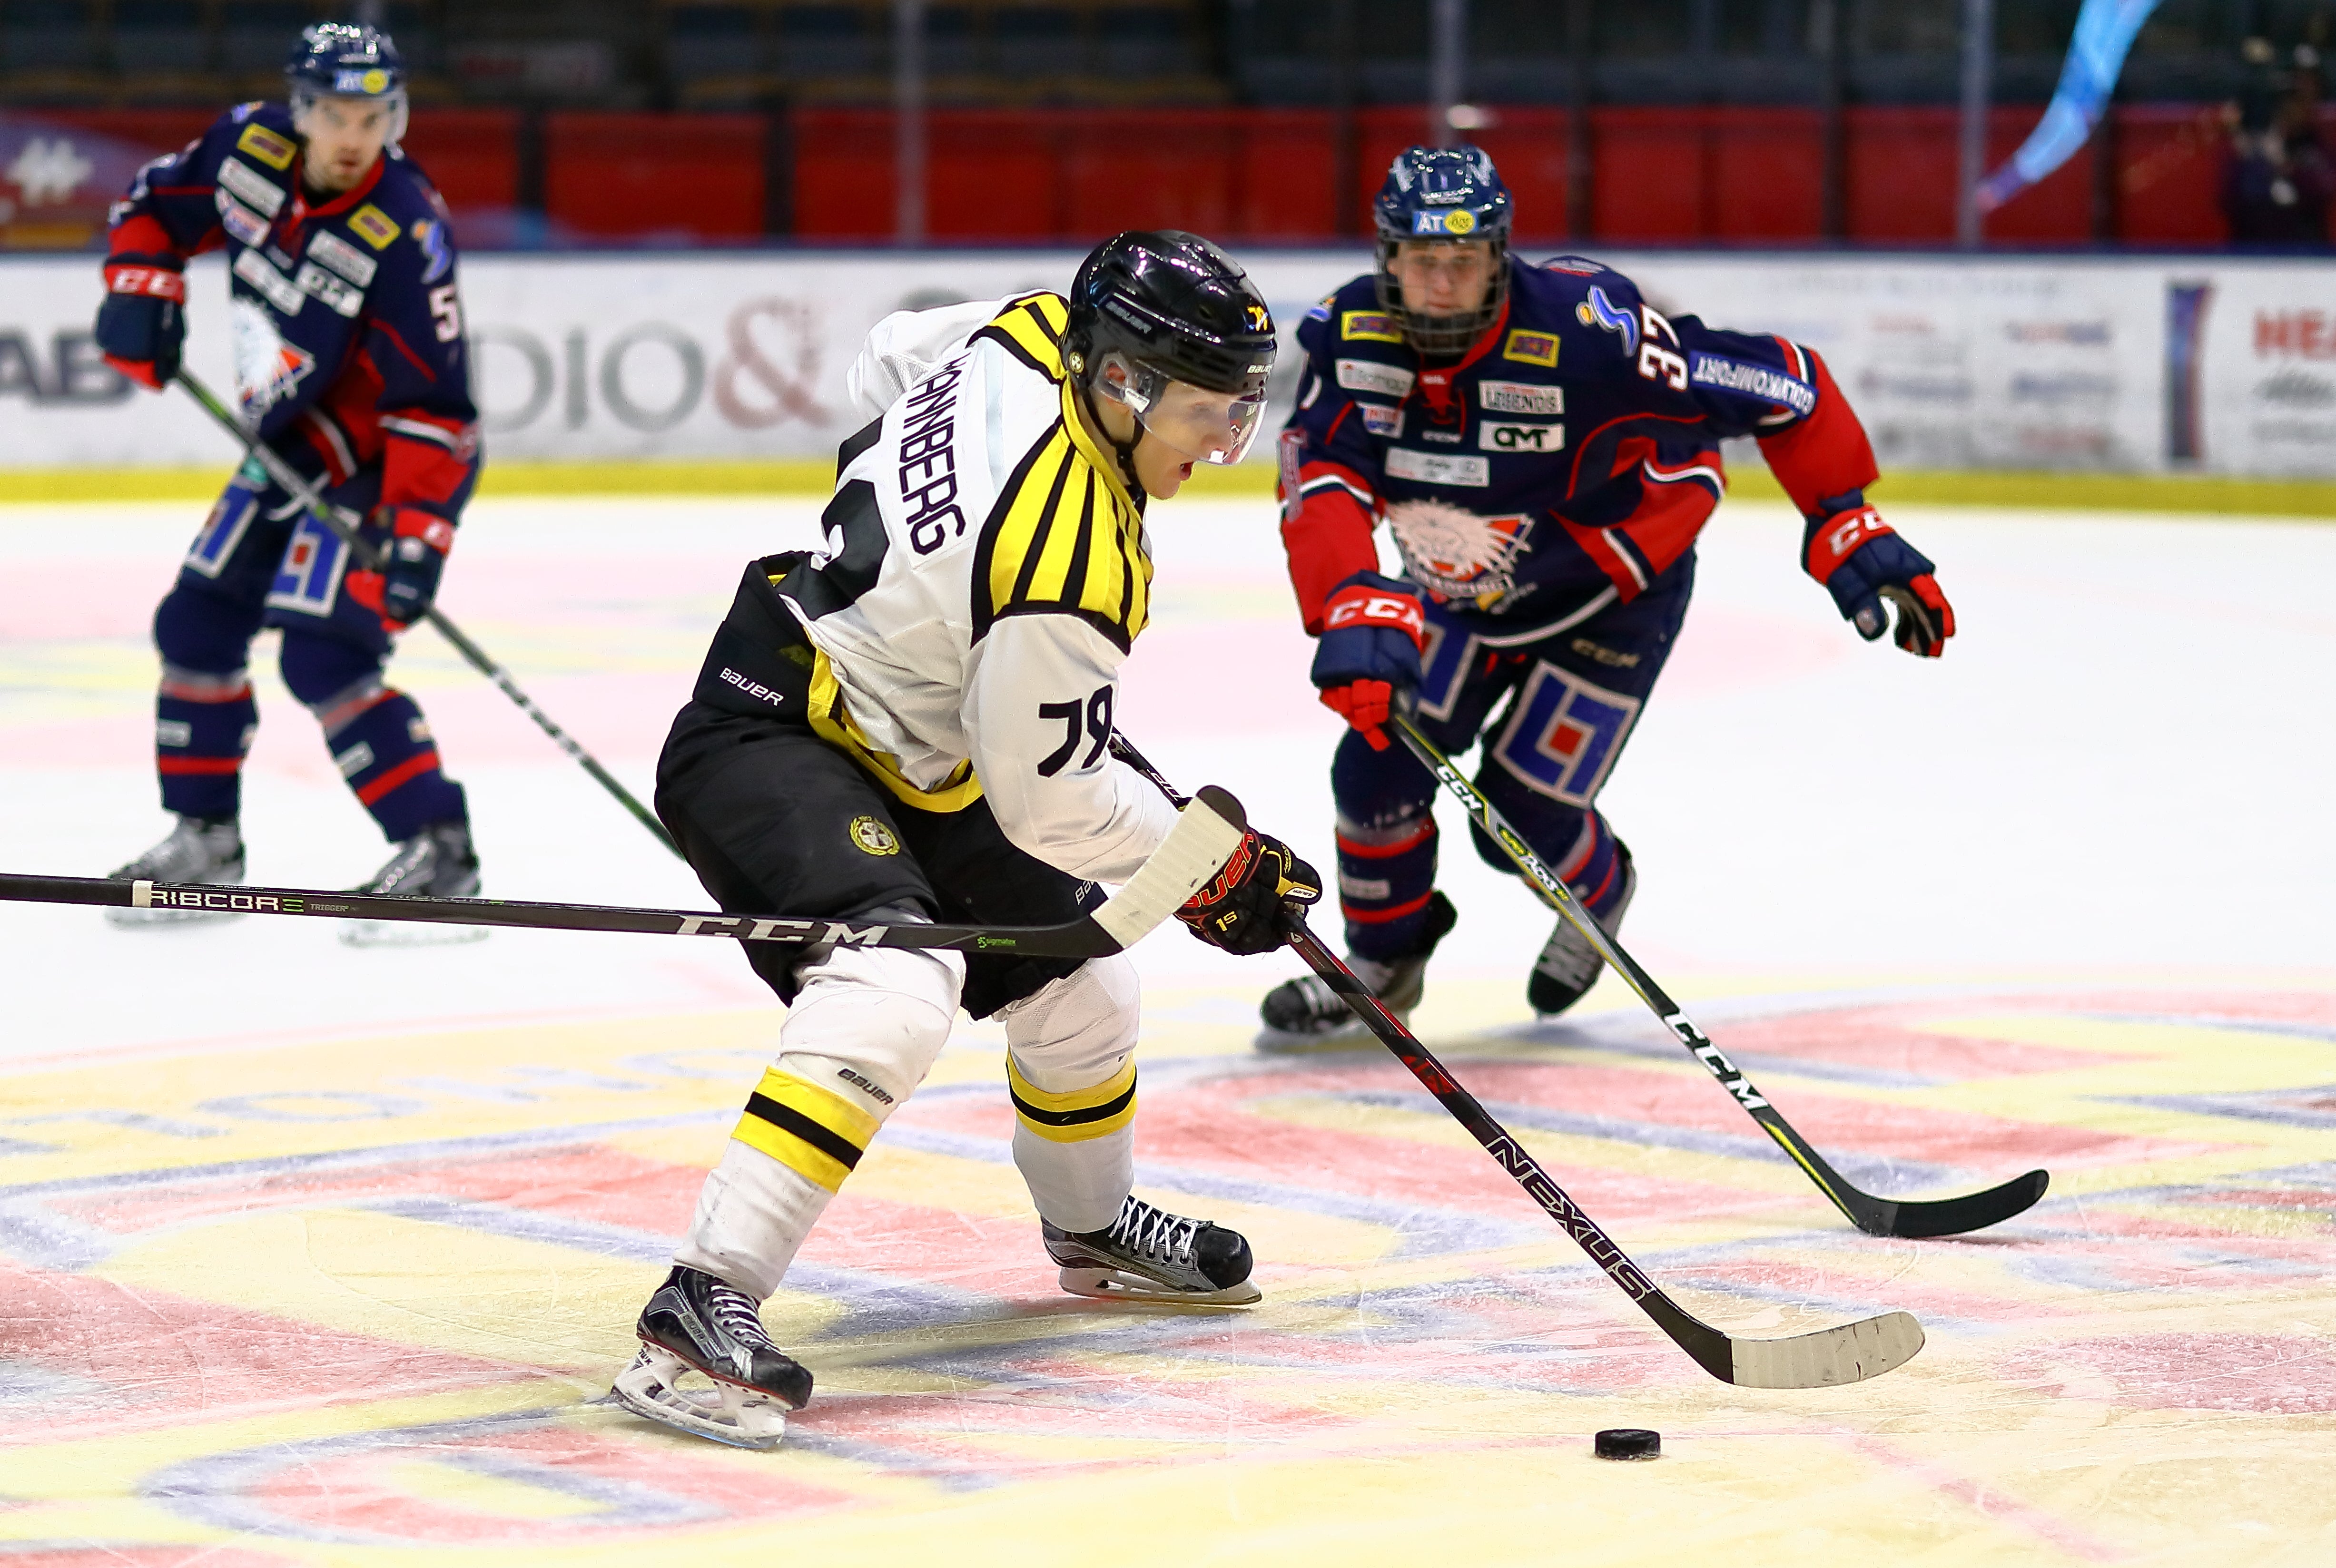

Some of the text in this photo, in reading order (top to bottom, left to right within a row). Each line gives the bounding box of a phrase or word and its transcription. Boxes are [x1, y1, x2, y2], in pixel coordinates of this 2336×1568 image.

[1638, 303, 1688, 392] 37
[719, 667, 784, 706] BAUER
[1037, 684, 1114, 778] 79
[676, 914, 889, 946] CCM
[838, 1068, 894, 1105] BAUER
[1664, 1009, 1769, 1110] CCM
[1485, 1136, 1656, 1302] NEXUS
